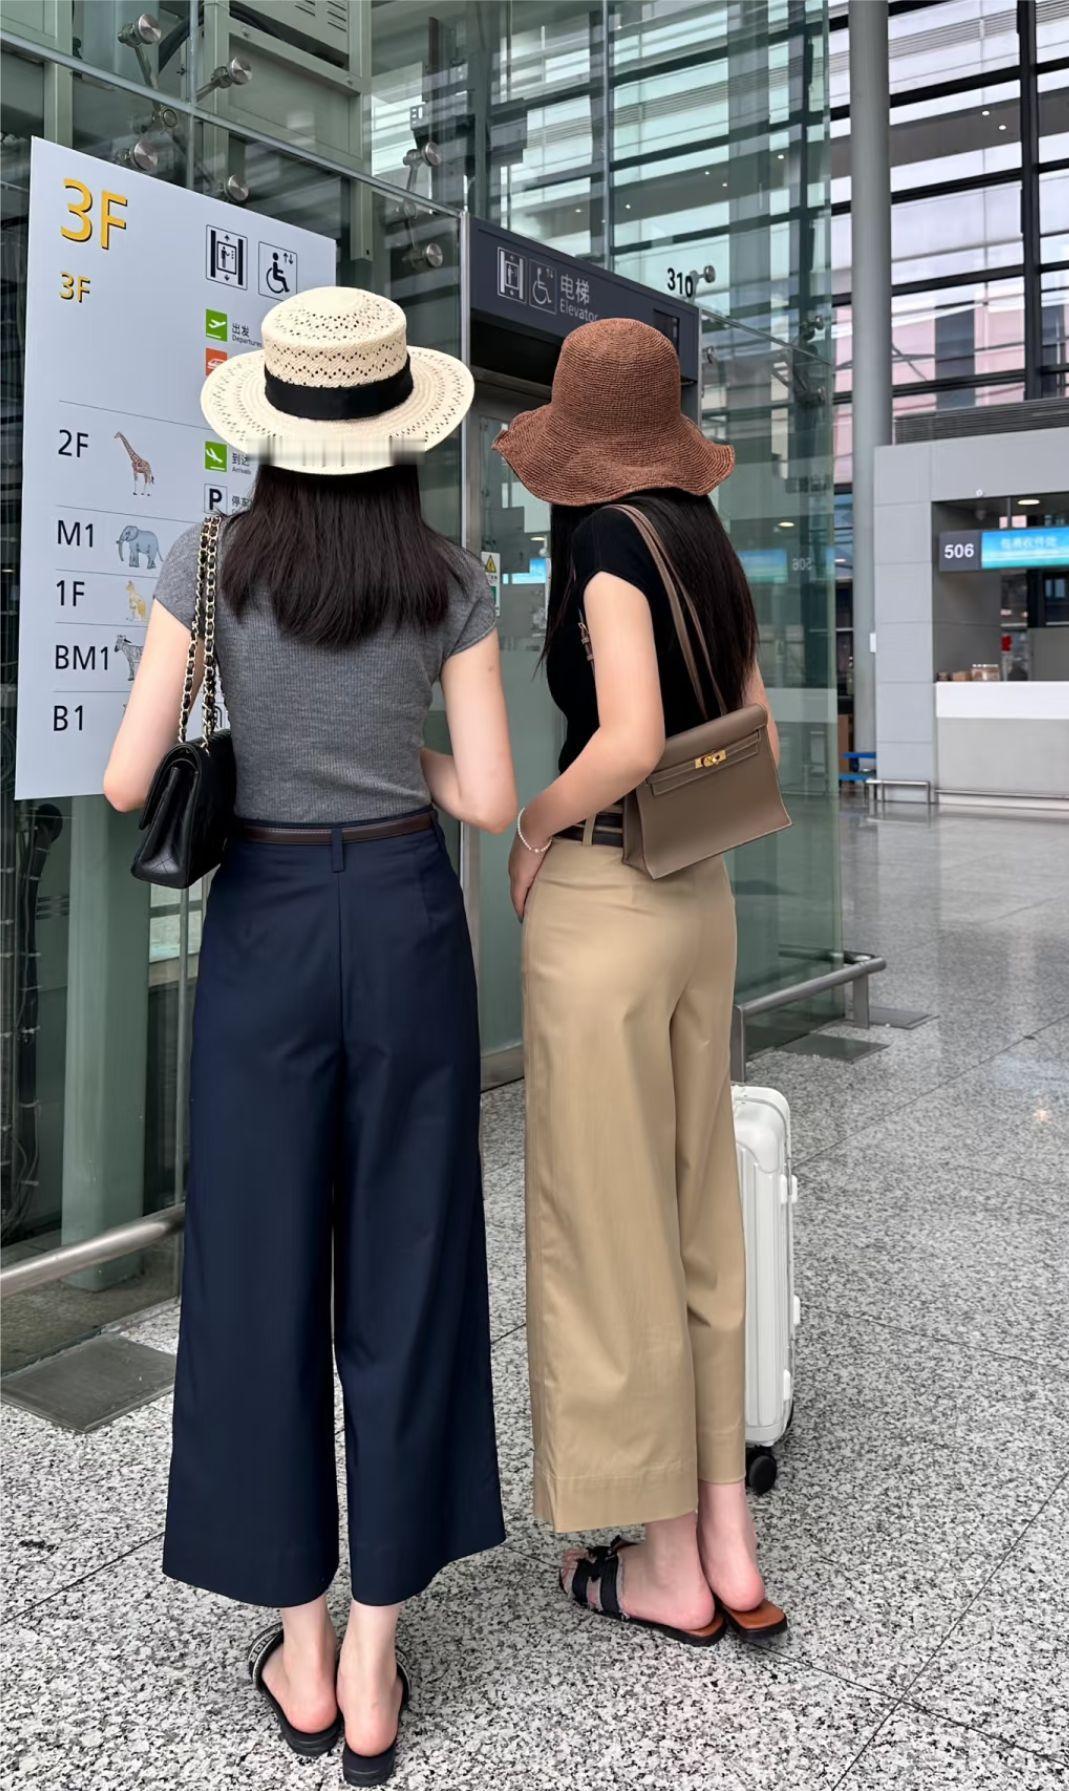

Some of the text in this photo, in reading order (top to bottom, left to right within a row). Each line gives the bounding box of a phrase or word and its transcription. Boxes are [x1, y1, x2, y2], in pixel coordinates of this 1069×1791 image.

[60, 178, 128, 250] 3F
[59, 272, 91, 303] 3F
[560, 274, 590, 305] 电梯
[667, 267, 694, 298] 310
[560, 298, 599, 322] Elevator
[232, 322, 249, 338] 出发
[58, 429, 89, 458] 2F
[209, 488, 222, 510] P
[57, 520, 94, 548] M1
[944, 543, 975, 559] 506
[56, 580, 85, 607] 1F
[55, 645, 108, 671] BM1
[53, 705, 84, 731] B1
